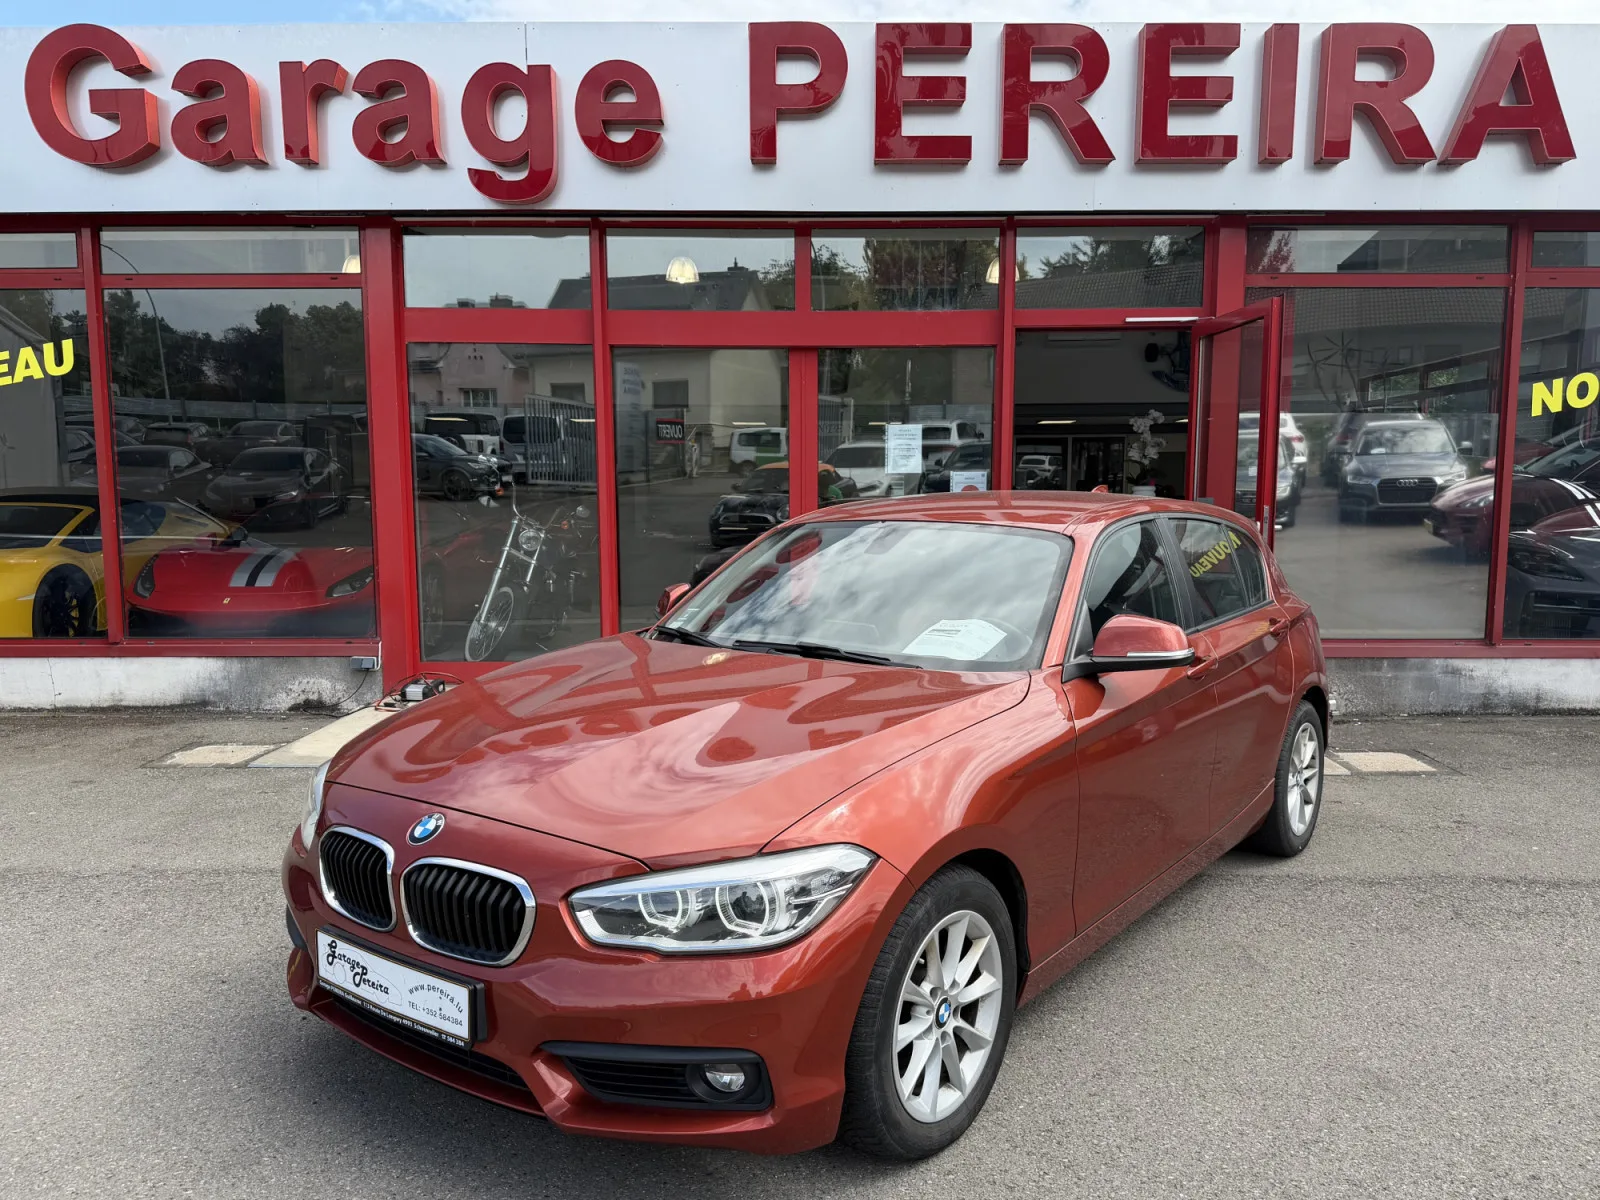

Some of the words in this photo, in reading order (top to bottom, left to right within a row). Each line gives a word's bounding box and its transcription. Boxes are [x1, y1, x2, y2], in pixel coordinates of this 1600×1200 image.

[24, 22, 664, 206] Garage
[748, 22, 1576, 166] PEREIRA
[1531, 372, 1600, 417] NO
[326, 940, 362, 972] Garage
[353, 964, 390, 995] Pereira
[408, 983, 464, 1014] www.pereira.lu
[408, 1000, 421, 1012] TEL:
[422, 1006, 438, 1018] +352
[438, 1012, 463, 1027] 584384
